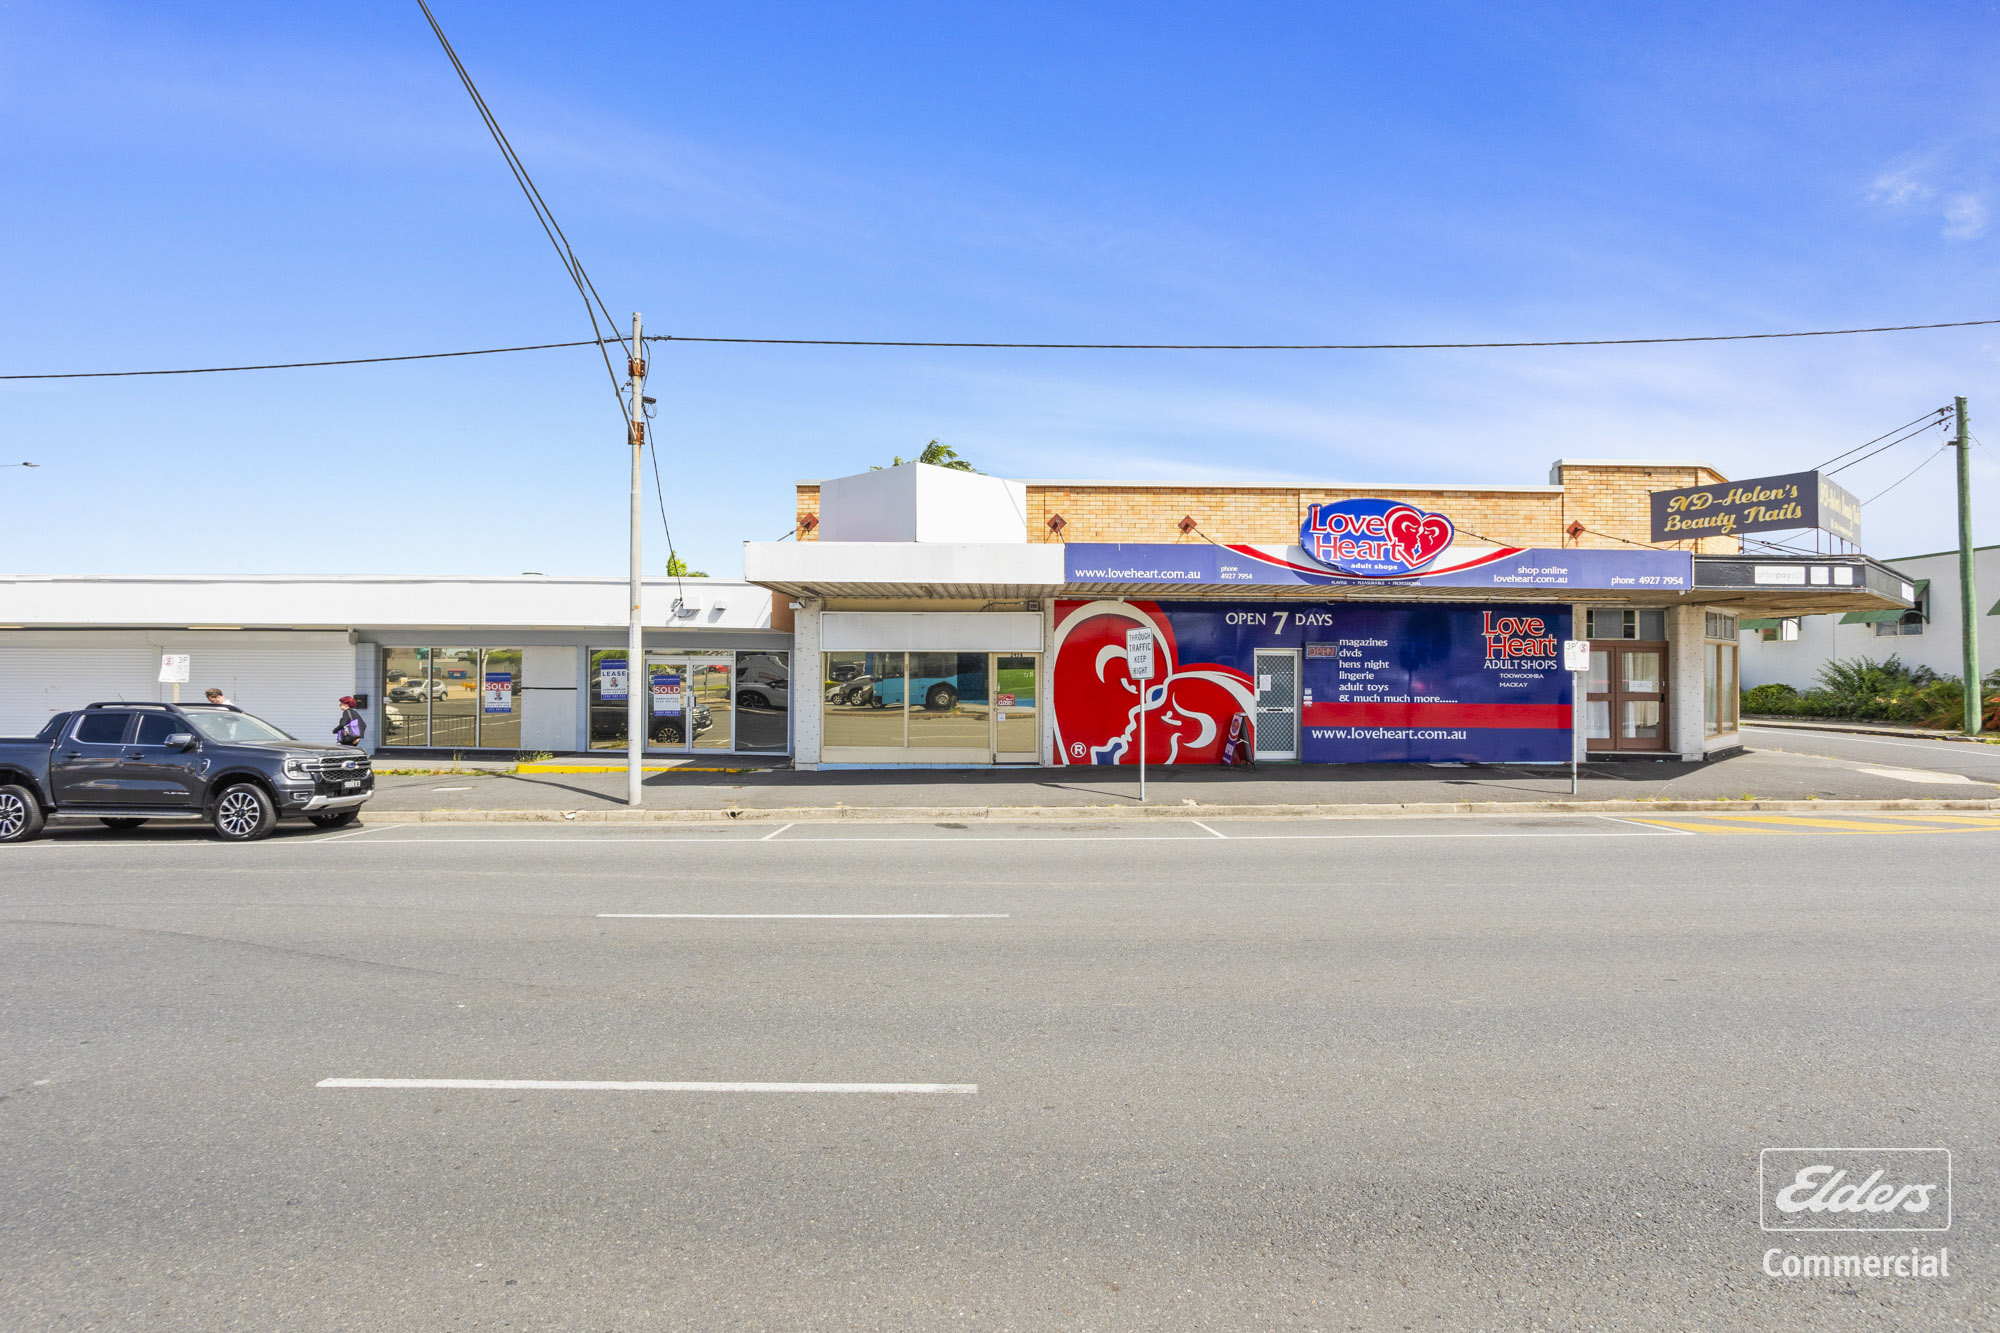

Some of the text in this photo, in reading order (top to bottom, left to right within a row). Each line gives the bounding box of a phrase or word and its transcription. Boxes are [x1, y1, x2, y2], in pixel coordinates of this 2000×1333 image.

[1666, 484, 1798, 513] ND-Helen's
[1309, 505, 1386, 536] Love
[1664, 512, 1737, 534] Beauty
[1744, 502, 1802, 524] Nails
[1314, 534, 1404, 562] Heart
[1075, 568, 1201, 580] www.loveheart.com.au
[1220, 565, 1239, 573] phone
[1517, 566, 1568, 576] shop online
[1493, 575, 1568, 584] loveheart.com.au
[1611, 576, 1684, 586] phone 4927 7954
[1225, 611, 1333, 635] OPEN 7 DAYS
[1481, 611, 1546, 636] Love
[1129, 632, 1150, 642] THROUGH
[1129, 642, 1152, 652] TRAFFIC
[1339, 638, 1388, 647] magazines
[1485, 634, 1557, 659] Heart
[1308, 647, 1335, 656] OPEN
[1339, 649, 1362, 657] dvds
[1134, 655, 1147, 663] KEEP
[1339, 660, 1389, 670] hens night
[1484, 660, 1557, 670] ADULT SHOPS
[1133, 666, 1148, 675] RIGHT
[1339, 671, 1374, 680] lingerie
[655, 686, 680, 694] SOLD
[1339, 682, 1389, 693] adult toys
[1339, 694, 1349, 702] &
[1353, 694, 1380, 702] much
[1384, 694, 1410, 703] much
[1312, 727, 1467, 740] www.loveheart.com.au
